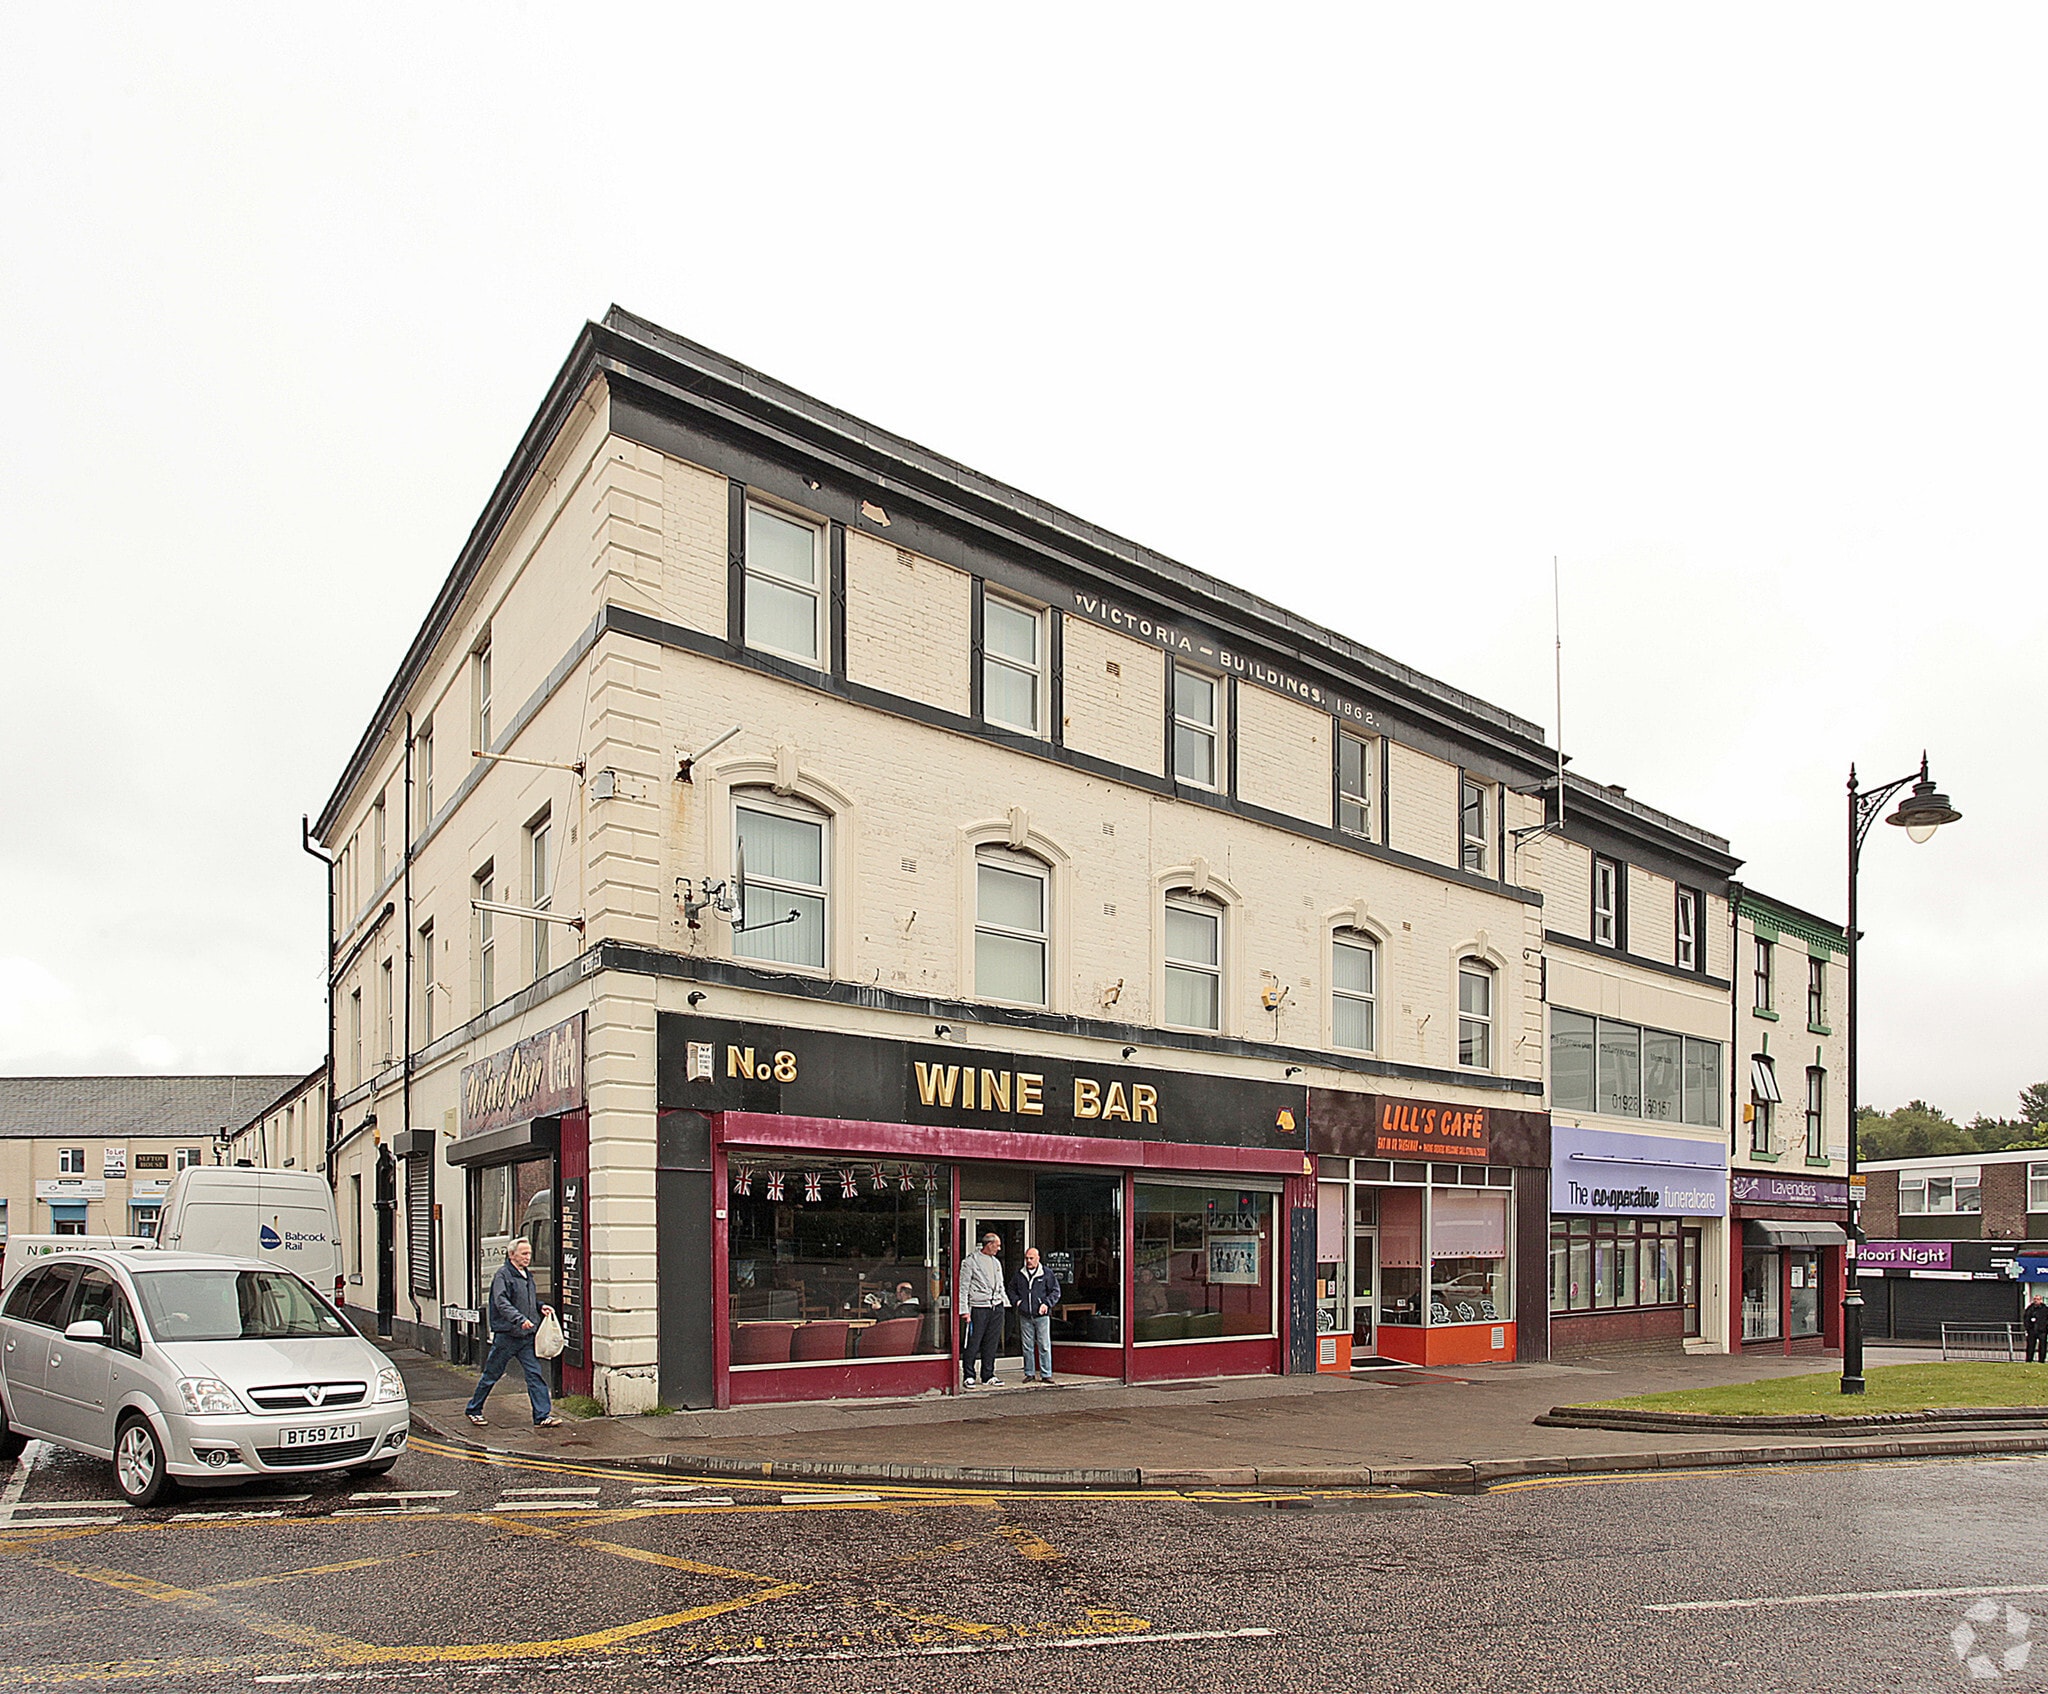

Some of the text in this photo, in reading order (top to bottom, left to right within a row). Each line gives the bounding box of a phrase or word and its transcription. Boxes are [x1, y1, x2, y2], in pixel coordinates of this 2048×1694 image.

[1082, 594, 1192, 653] VICTORIA
[914, 1061, 1159, 1124] WINE BAR
[1611, 1093, 1639, 1112] 01928
[1382, 1103, 1484, 1139] LILL'S CAFÉ
[114, 1148, 125, 1156] Let
[1568, 1180, 1716, 1212] The co-operative funeralcare
[1772, 1180, 1817, 1197] Lavenders
[285, 1231, 326, 1242] Babcock
[285, 1242, 303, 1251] Rail
[1857, 1247, 1946, 1265] doori Night
[287, 1425, 355, 1444] BT59 ZTJ
